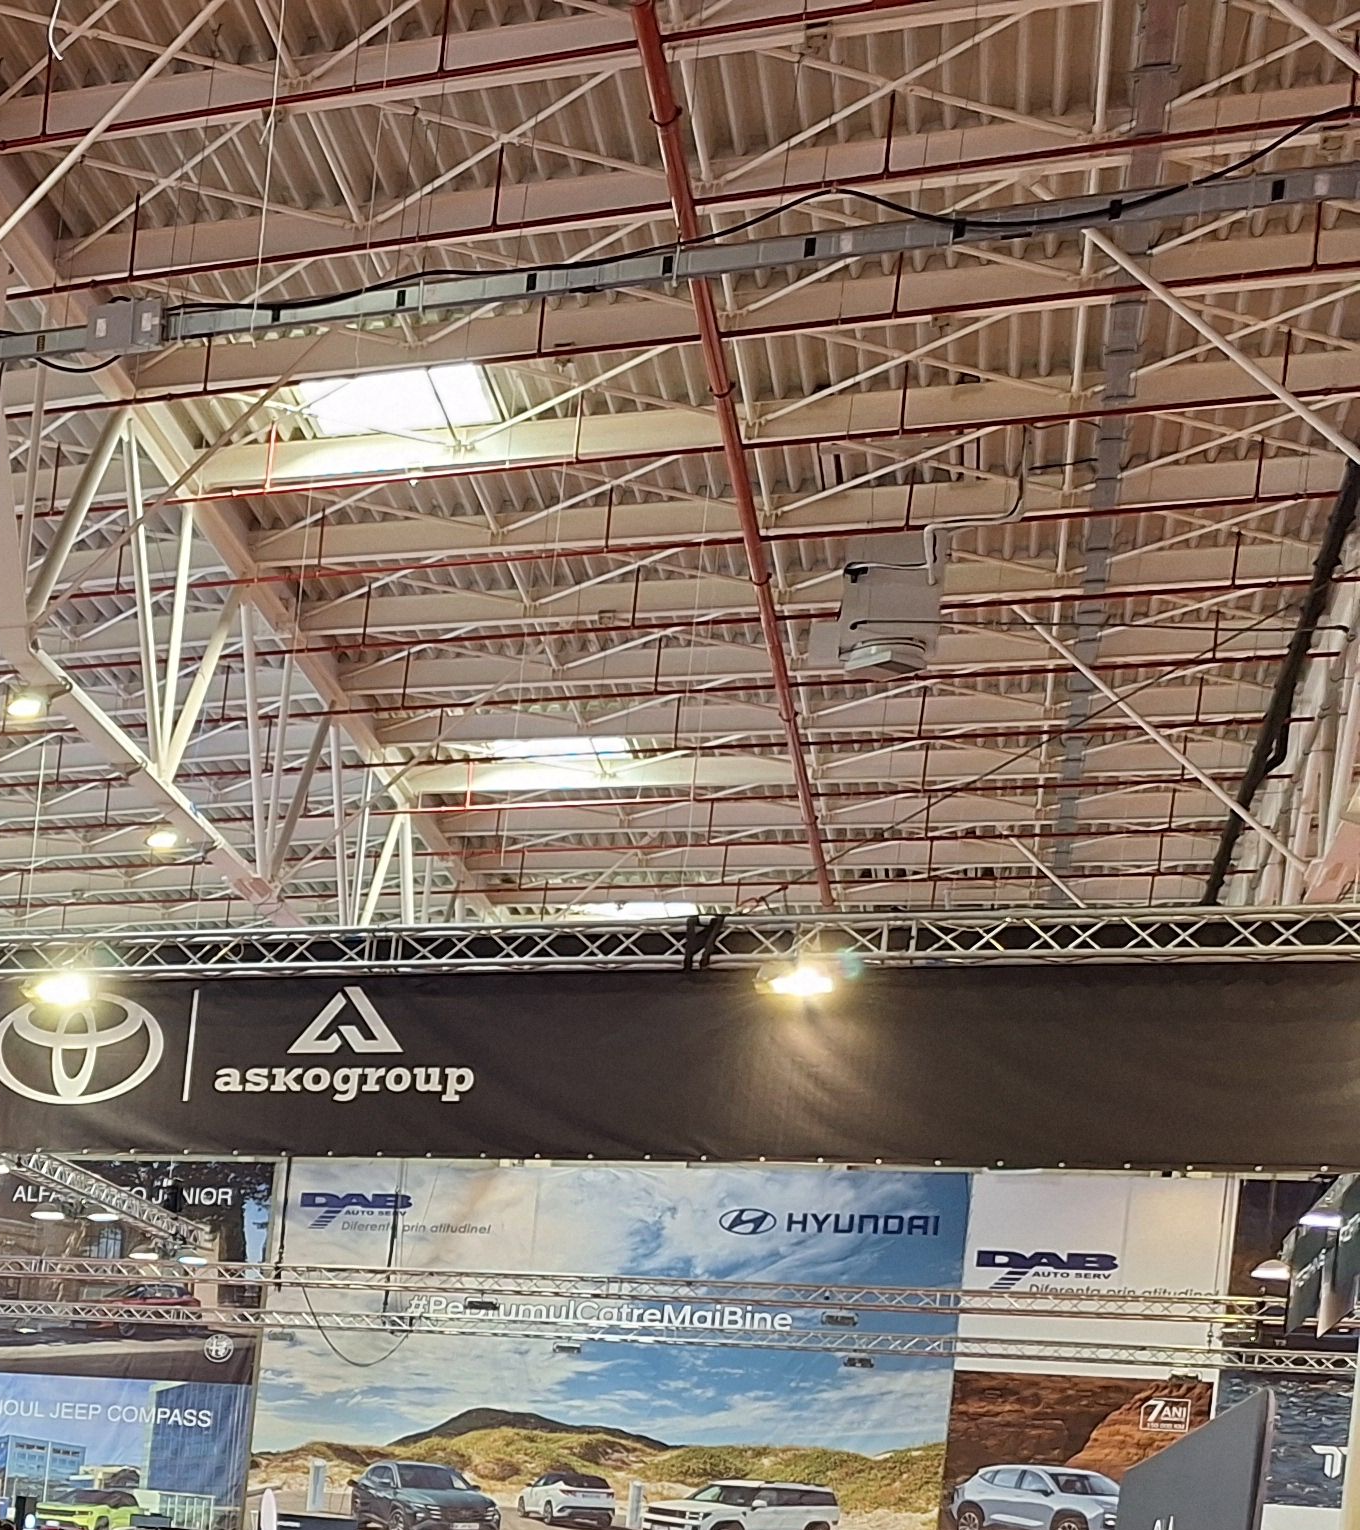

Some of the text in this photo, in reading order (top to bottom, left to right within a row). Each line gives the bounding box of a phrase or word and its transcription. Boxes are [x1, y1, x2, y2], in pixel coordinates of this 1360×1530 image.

[215, 1064, 474, 1101] askogroup
[152, 1187, 232, 1206] JNIOR
[300, 1192, 413, 1210] DAB
[341, 1221, 393, 1232] Diferent
[785, 1212, 939, 1238] HYUNDAI
[975, 1250, 1118, 1271] DAB
[1032, 1271, 1112, 1280] AUTO SERV
[49, 1402, 101, 1420] JEEP
[107, 1405, 212, 1428] COMPASS
[1161, 1406, 1187, 1418] ANI
